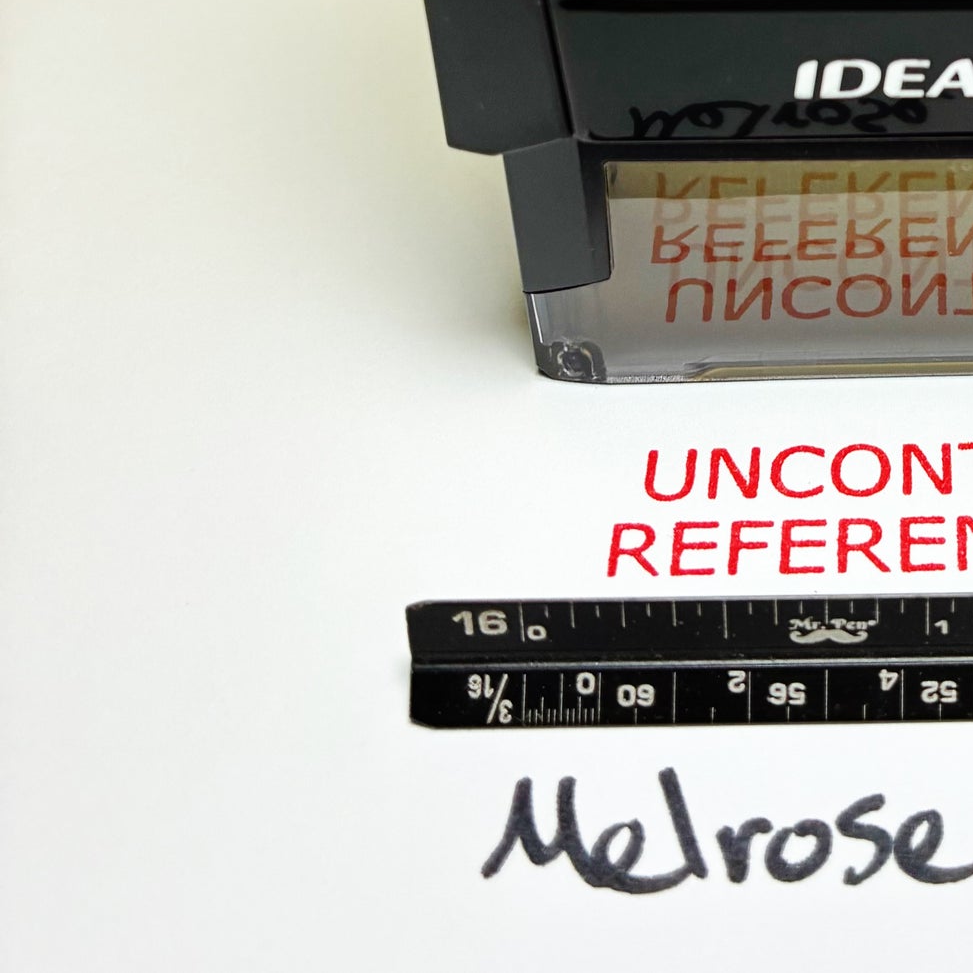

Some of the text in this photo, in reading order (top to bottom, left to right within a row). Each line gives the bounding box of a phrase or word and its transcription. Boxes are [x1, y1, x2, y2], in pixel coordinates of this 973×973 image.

[452, 610, 508, 636] 16
[526, 625, 548, 641] 0
[934, 619, 949, 635] 1
[788, 616, 826, 630] Mr.
[617, 683, 656, 707] 60
[767, 682, 806, 706] 56
[920, 680, 958, 704] 52
